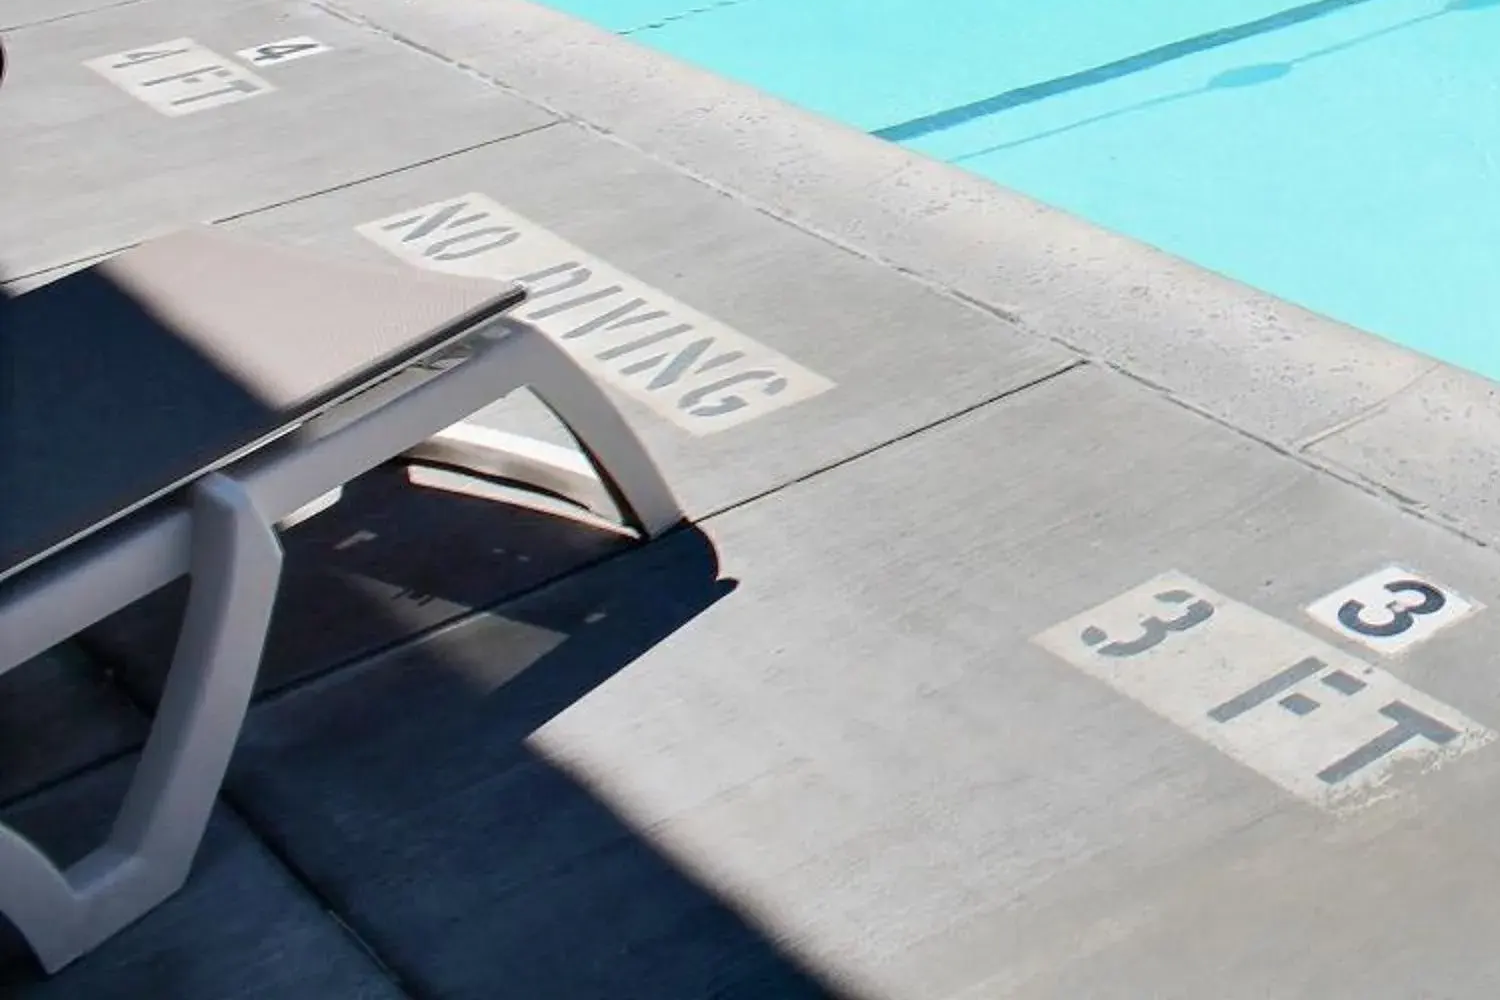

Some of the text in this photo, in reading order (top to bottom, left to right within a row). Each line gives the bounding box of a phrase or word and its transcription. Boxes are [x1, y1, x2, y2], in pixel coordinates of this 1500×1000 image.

[252, 42, 320, 63] 4
[141, 64, 261, 107] FT
[383, 200, 789, 418] NO DIVING
[1337, 578, 1447, 638] 3
[1079, 588, 1461, 785] 3 FT
